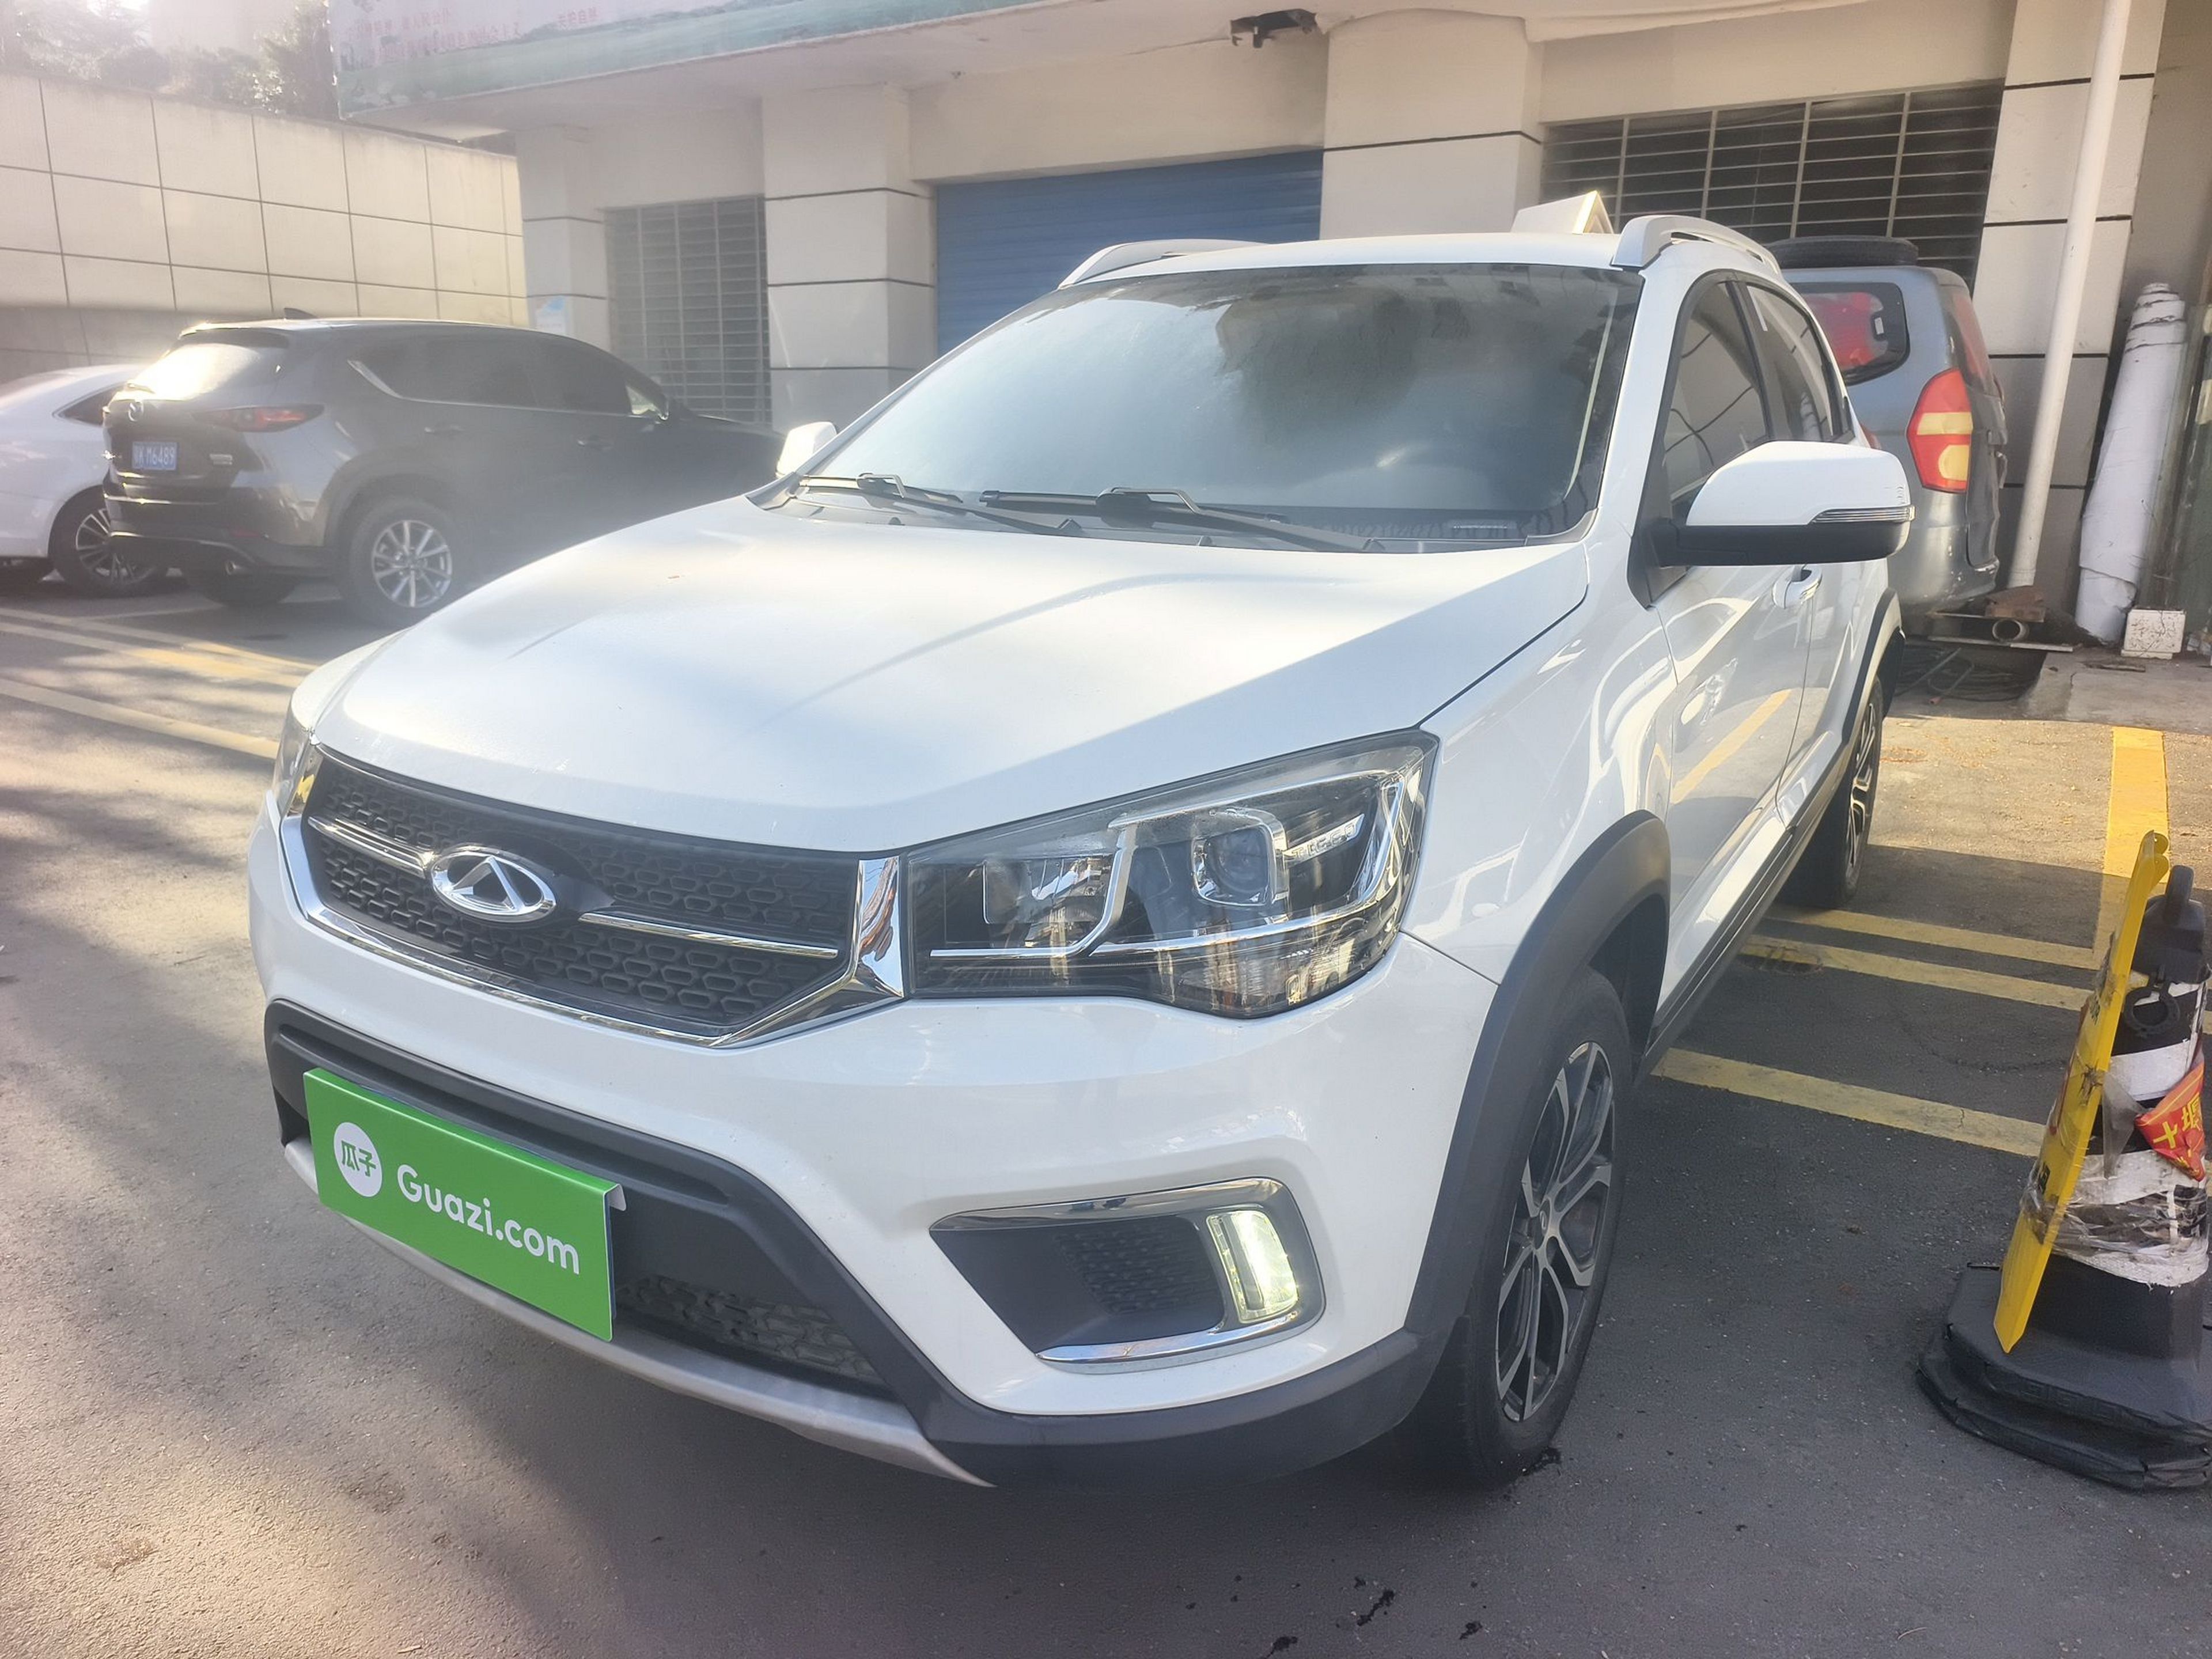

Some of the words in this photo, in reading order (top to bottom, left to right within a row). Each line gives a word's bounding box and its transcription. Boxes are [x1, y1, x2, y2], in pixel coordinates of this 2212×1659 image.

[1291, 822, 1355, 858] TIGGO
[341, 1140, 376, 1177] 瓜子
[397, 1164, 579, 1274] Guazi.com
